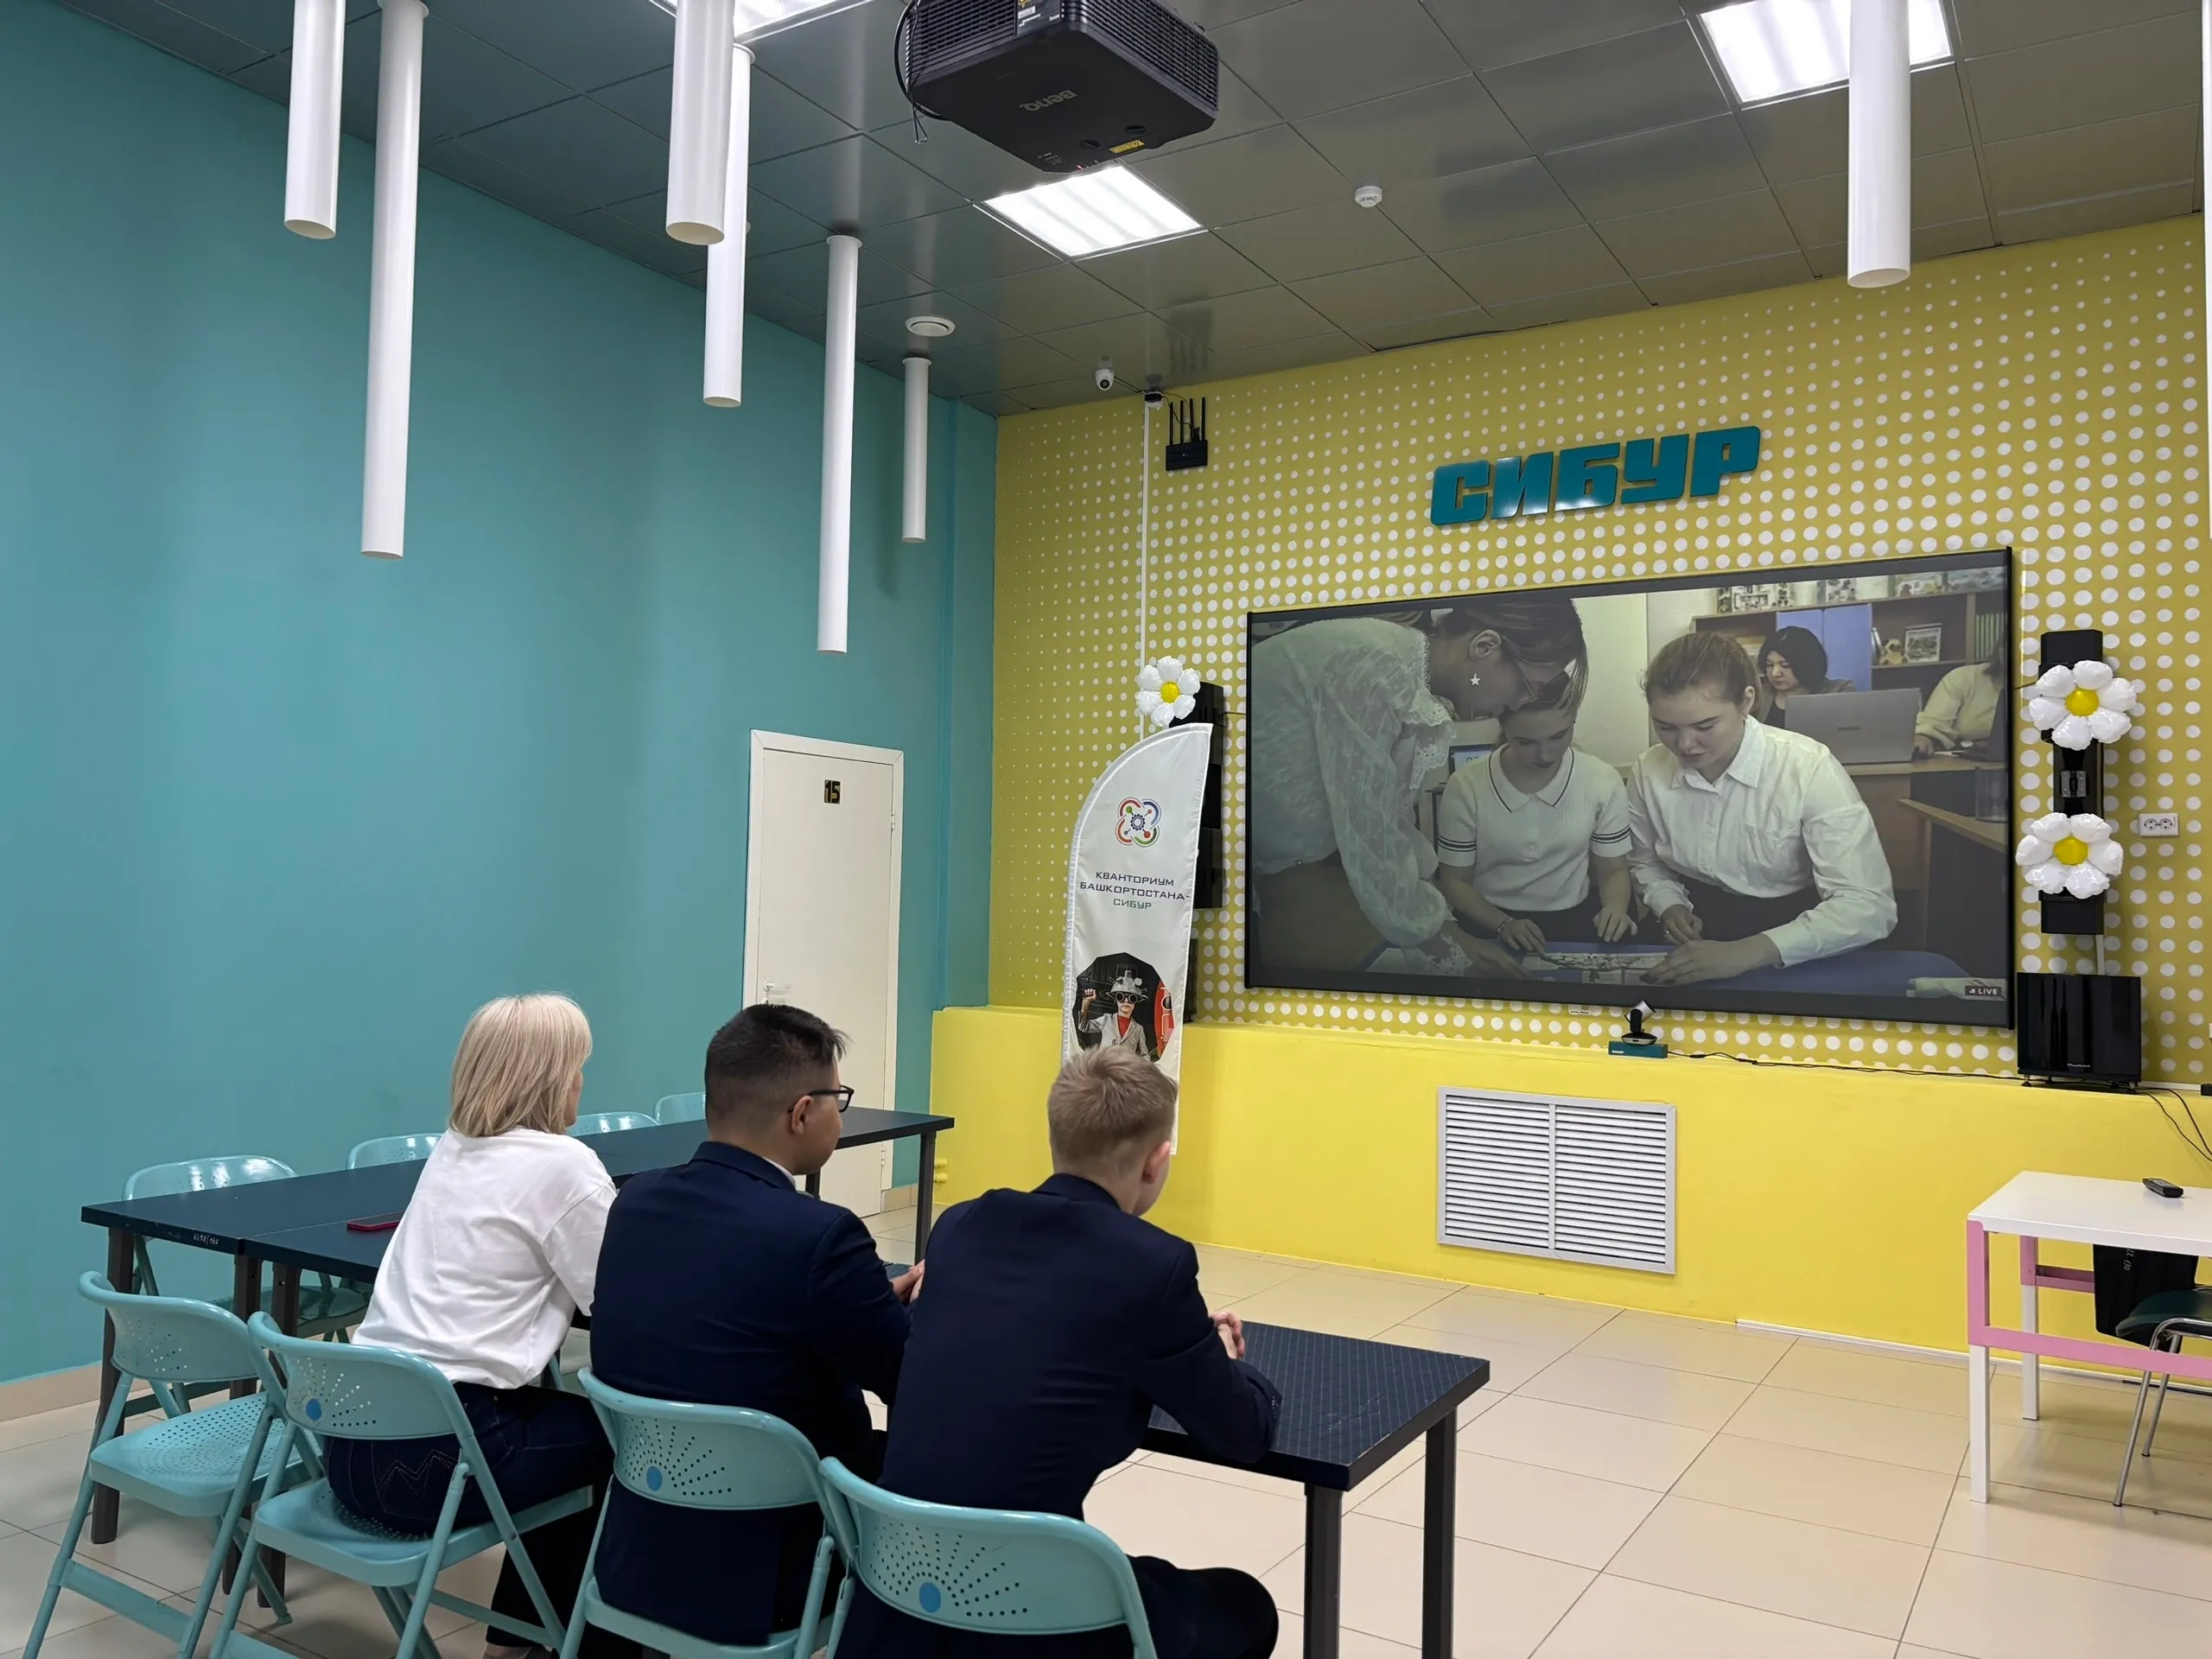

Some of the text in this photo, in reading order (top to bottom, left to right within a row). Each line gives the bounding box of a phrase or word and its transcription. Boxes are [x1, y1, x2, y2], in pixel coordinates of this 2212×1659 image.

[1019, 89, 1078, 111] BenQ
[1430, 426, 1761, 526] СИБУР
[824, 779, 841, 804] 15
[1096, 871, 1174, 887] КВАНТОРИУМ
[1113, 898, 1152, 910] СИБУР
